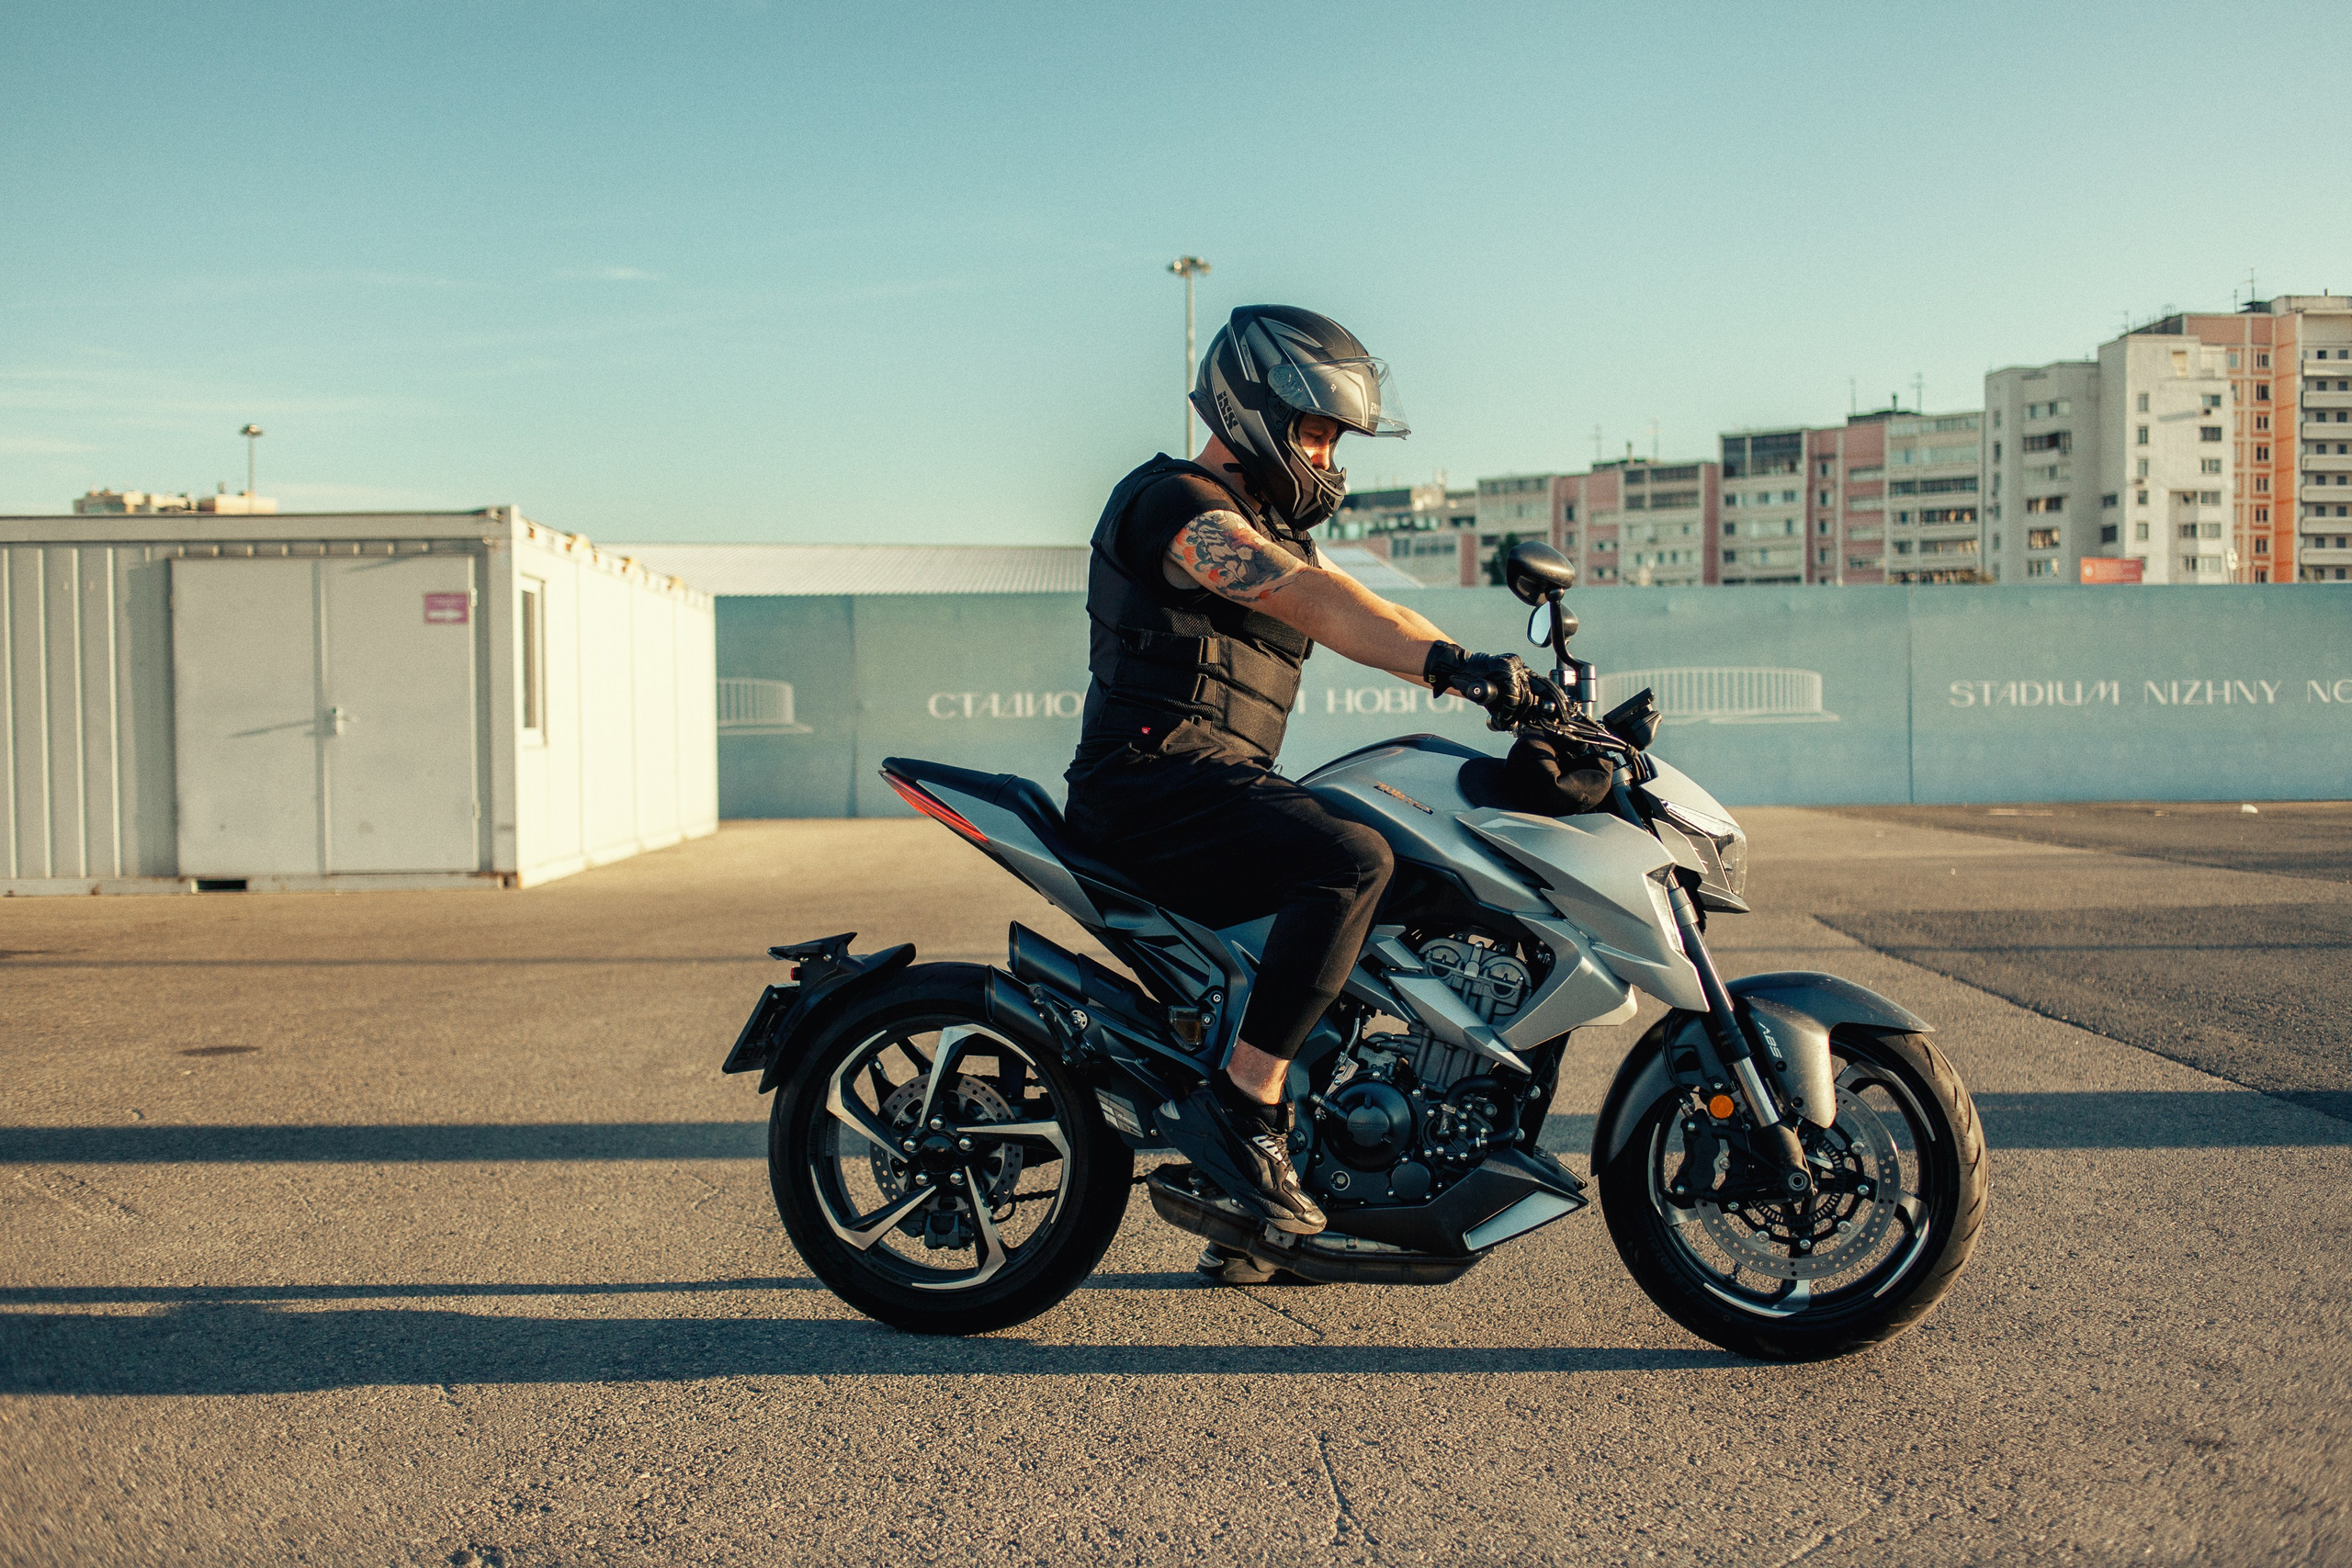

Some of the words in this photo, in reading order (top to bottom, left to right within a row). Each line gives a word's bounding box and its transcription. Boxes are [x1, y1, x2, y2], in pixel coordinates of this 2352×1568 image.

[928, 691, 1086, 719] СТАДИО
[1949, 680, 2120, 707] STADIUM
[2144, 679, 2282, 705] NIZHNY
[1758, 1021, 1782, 1059] ABS
